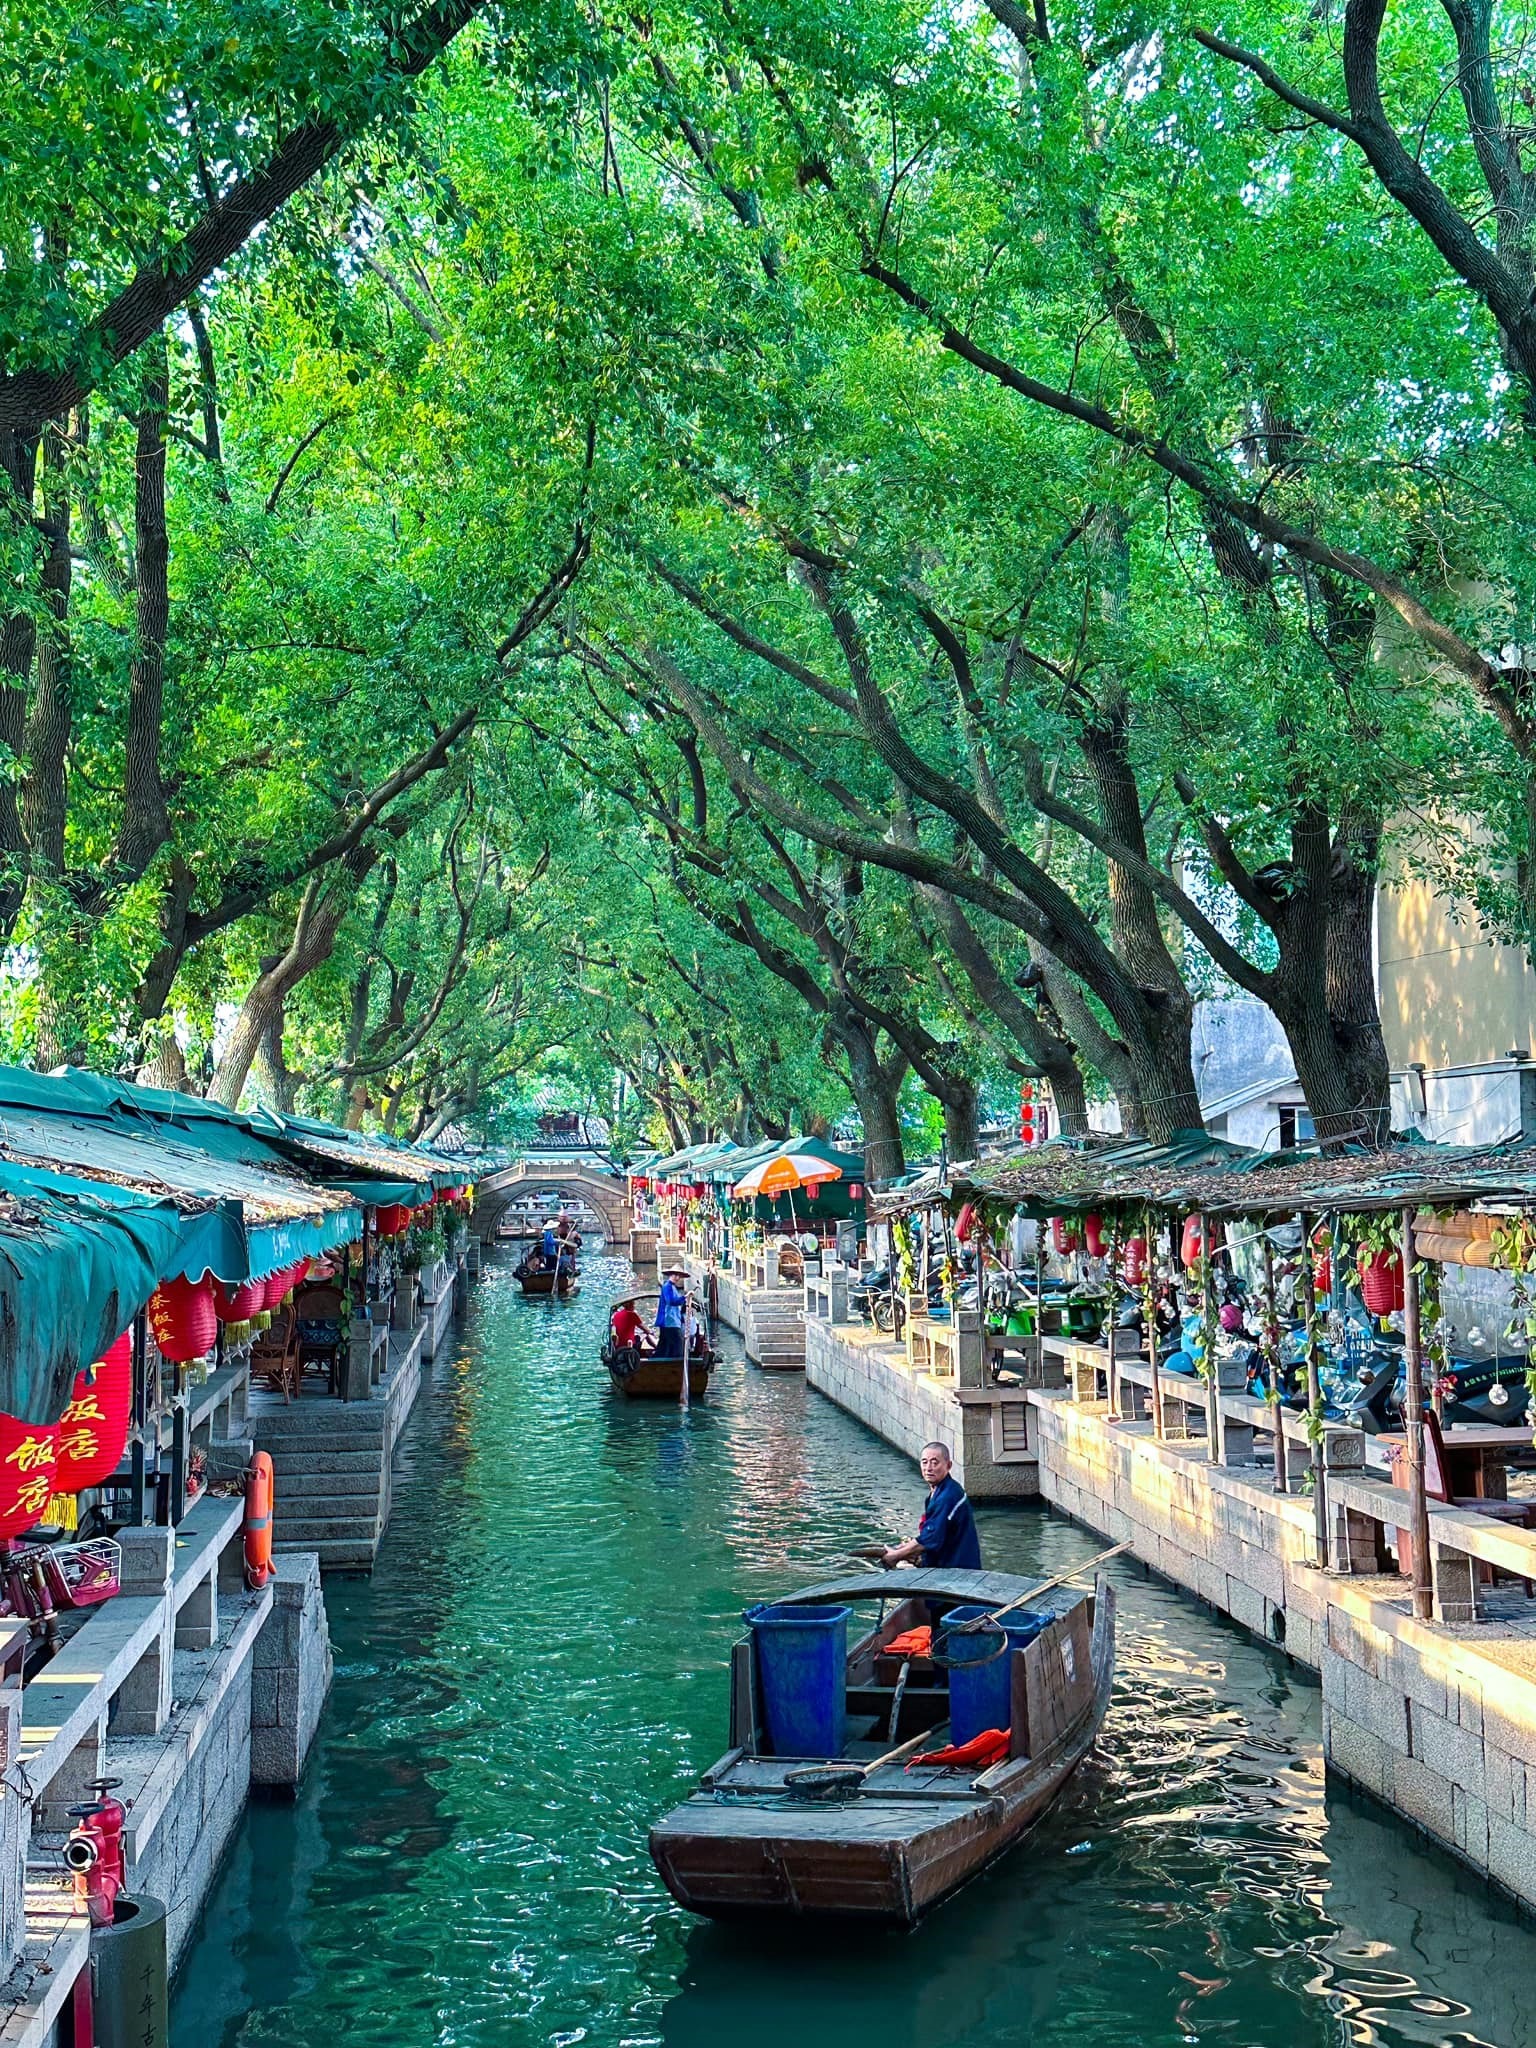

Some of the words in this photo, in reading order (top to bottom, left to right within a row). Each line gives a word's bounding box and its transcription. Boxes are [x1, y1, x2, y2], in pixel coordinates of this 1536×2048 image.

[57, 1361, 107, 1461] 饭店
[2, 1434, 57, 1518] 饭店
[138, 1963, 157, 2047] 千年古
